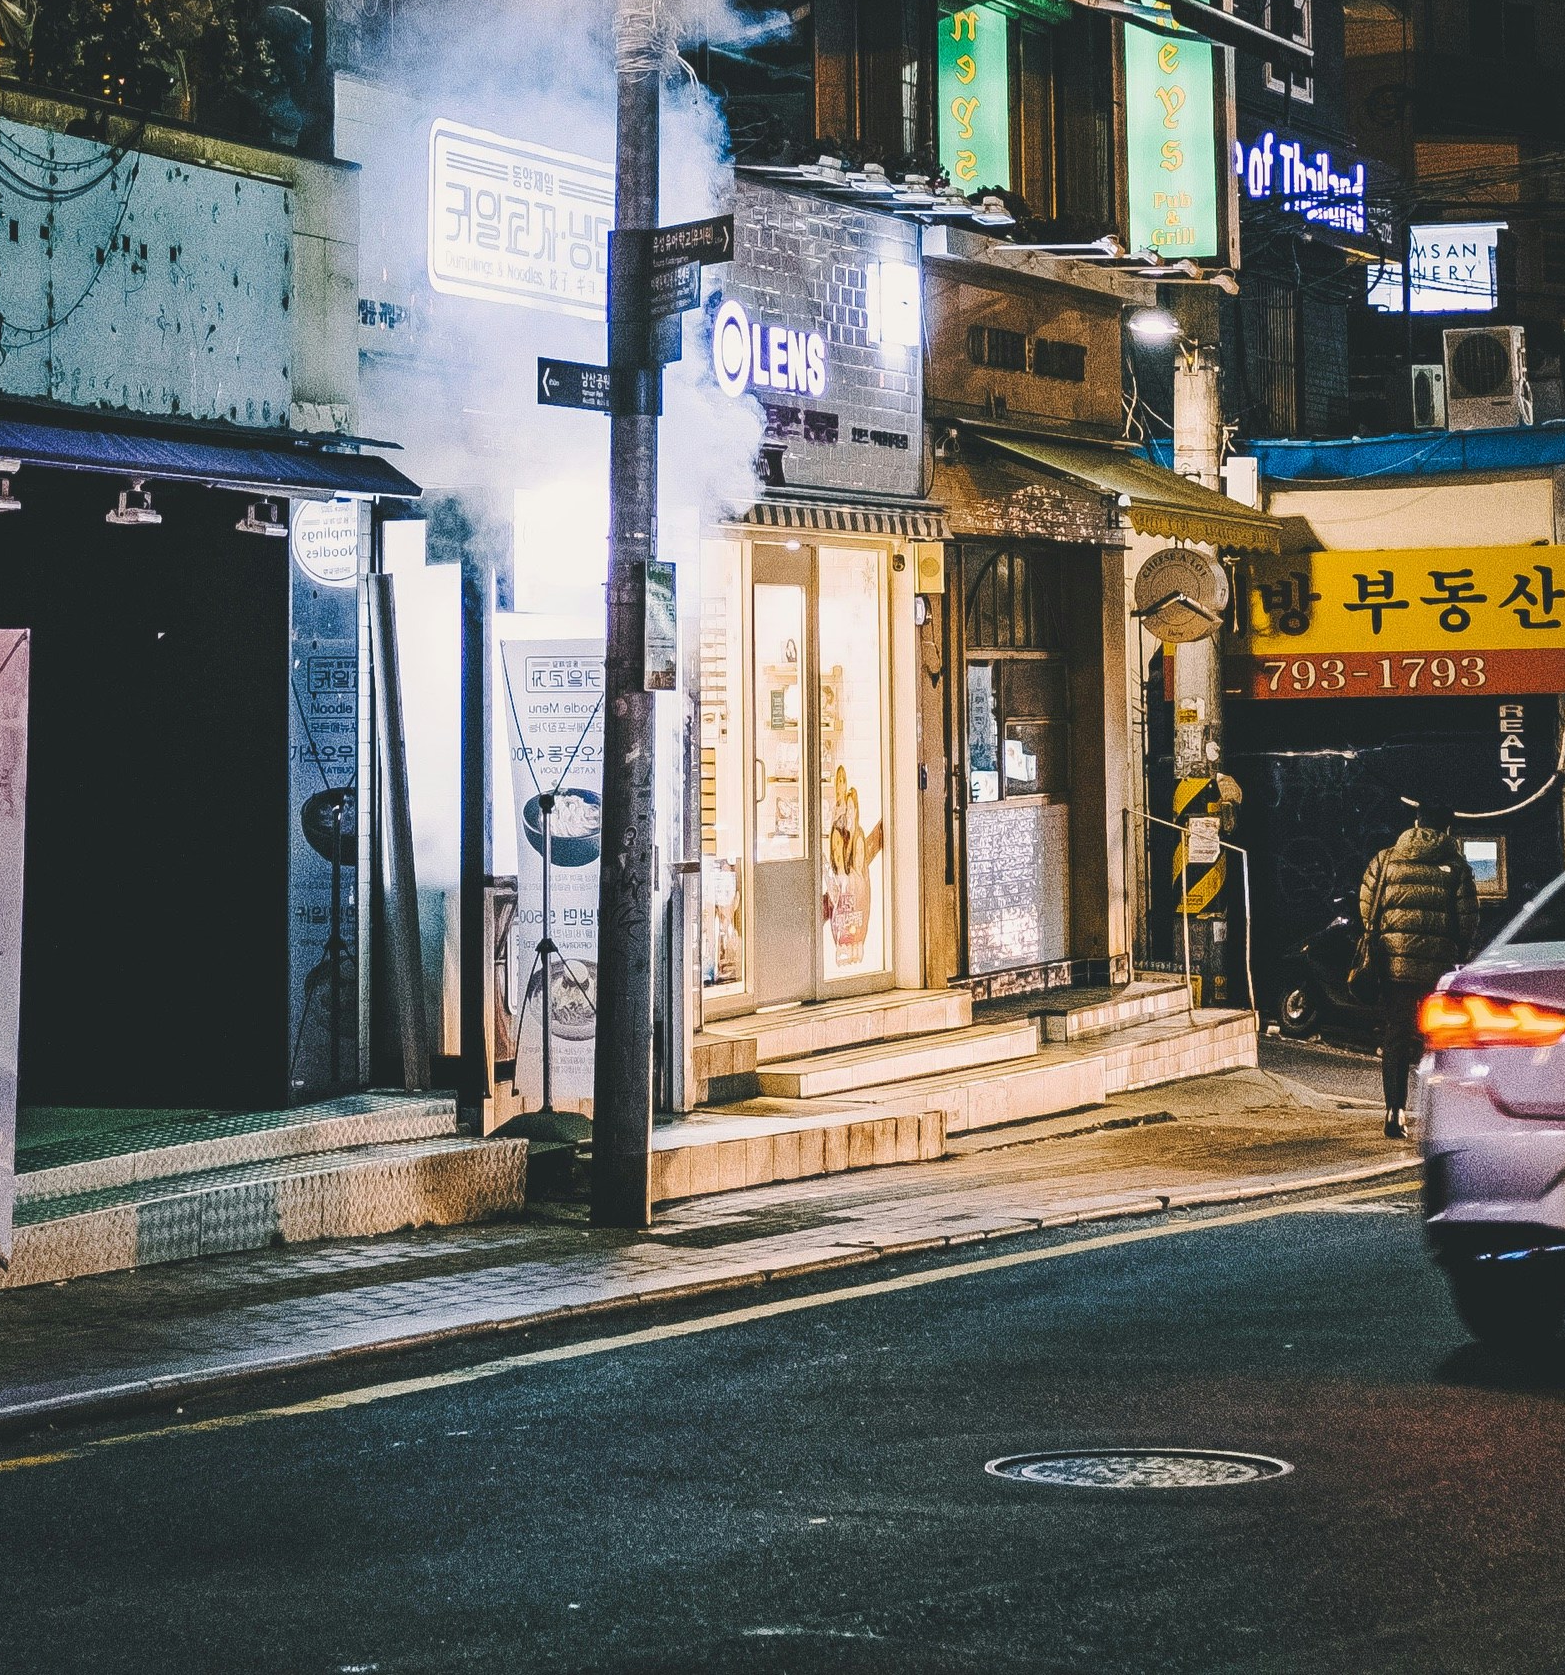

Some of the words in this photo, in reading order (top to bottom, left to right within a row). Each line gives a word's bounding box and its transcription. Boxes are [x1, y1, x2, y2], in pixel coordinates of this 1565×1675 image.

[1152, 189, 1192, 210] Pub
[1150, 226, 1197, 248] Grill
[444, 250, 496, 276] Dumplings
[1263, 655, 1488, 693] 793-1793
[1498, 704, 1527, 793] REALTY
